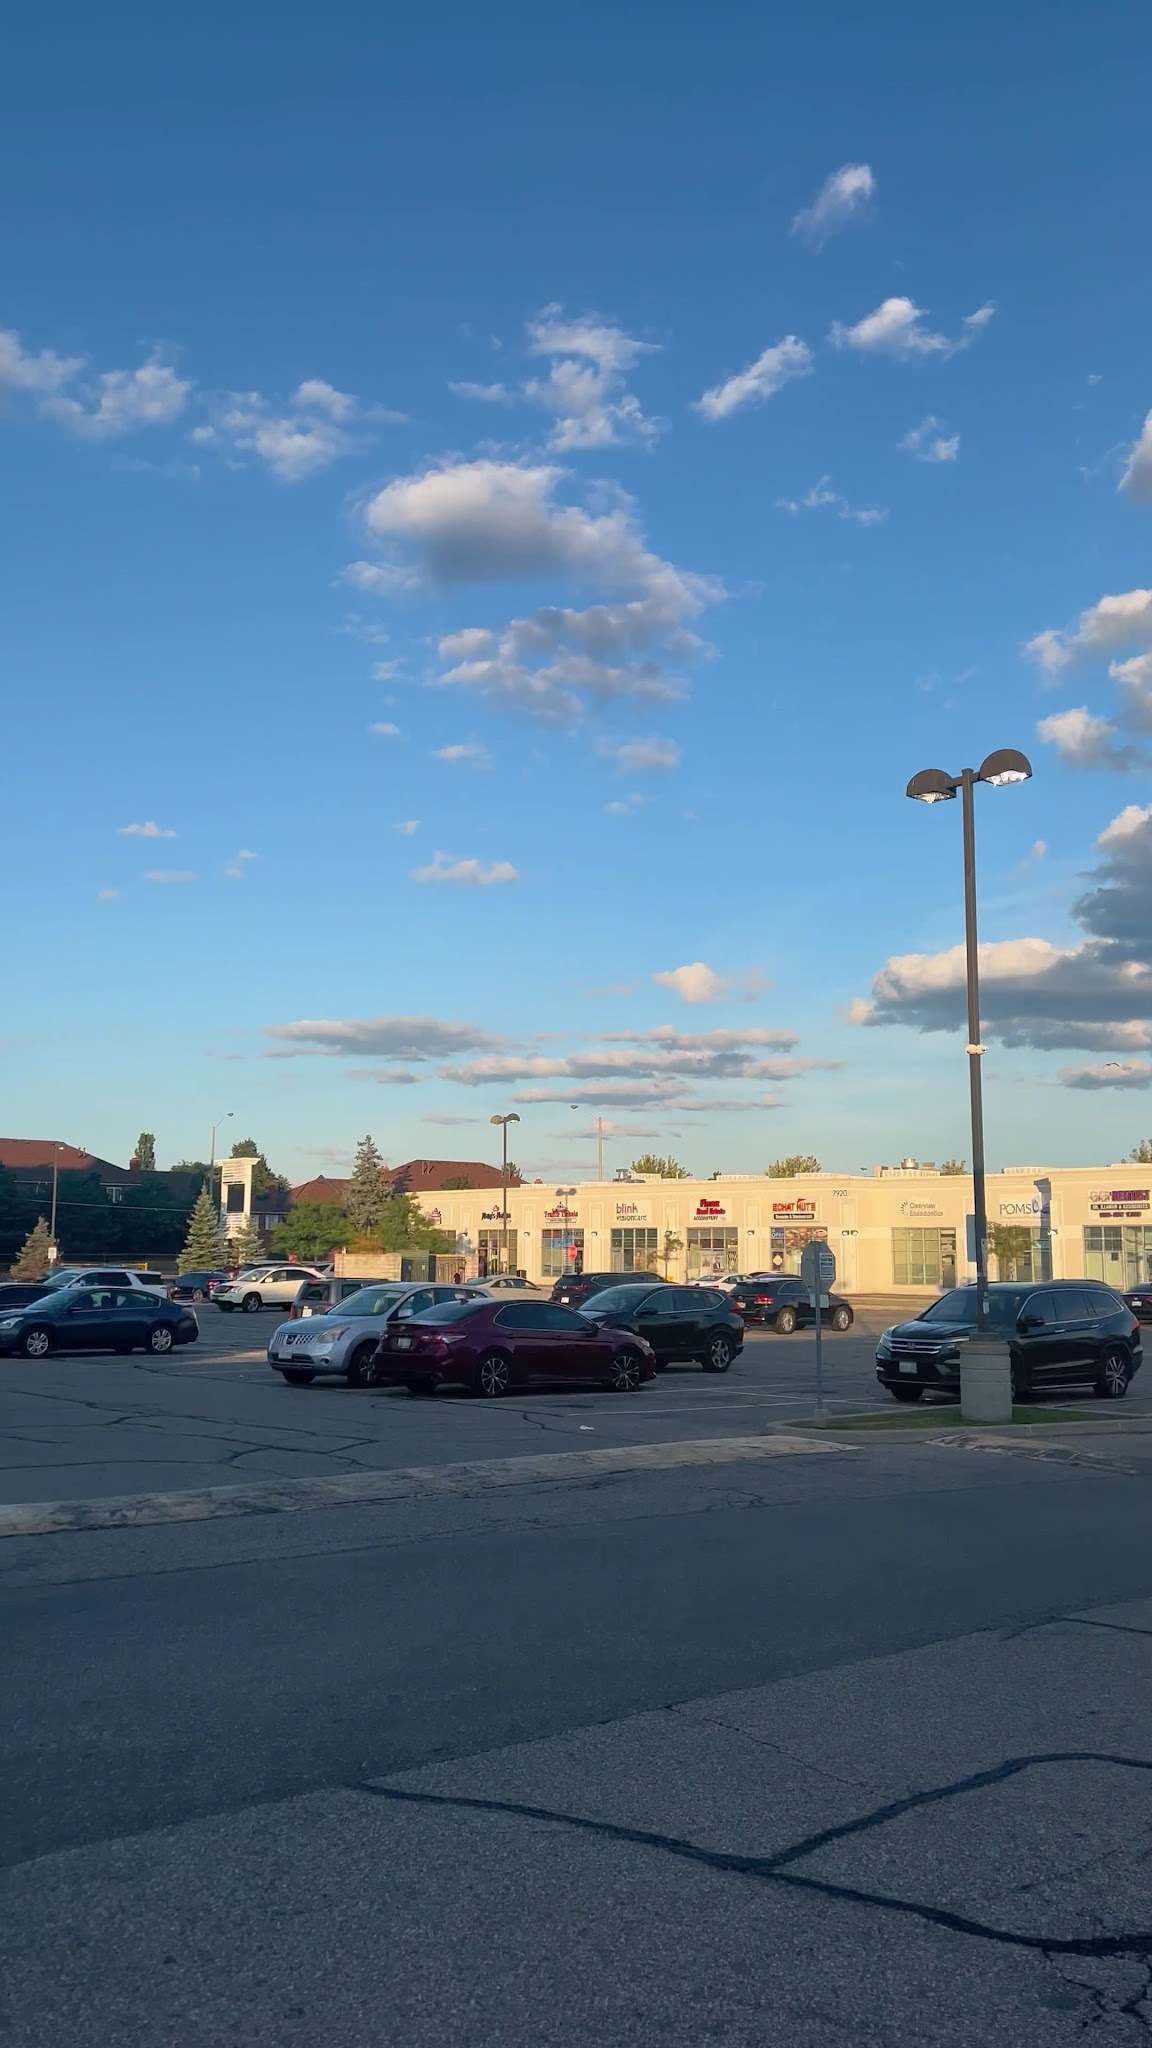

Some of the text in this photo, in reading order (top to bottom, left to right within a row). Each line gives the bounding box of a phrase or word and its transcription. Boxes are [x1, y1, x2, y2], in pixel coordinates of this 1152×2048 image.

[616, 1203, 638, 1214] blink
[777, 1203, 795, 1211] CHAT
[1000, 1204, 1031, 1214] POMS
